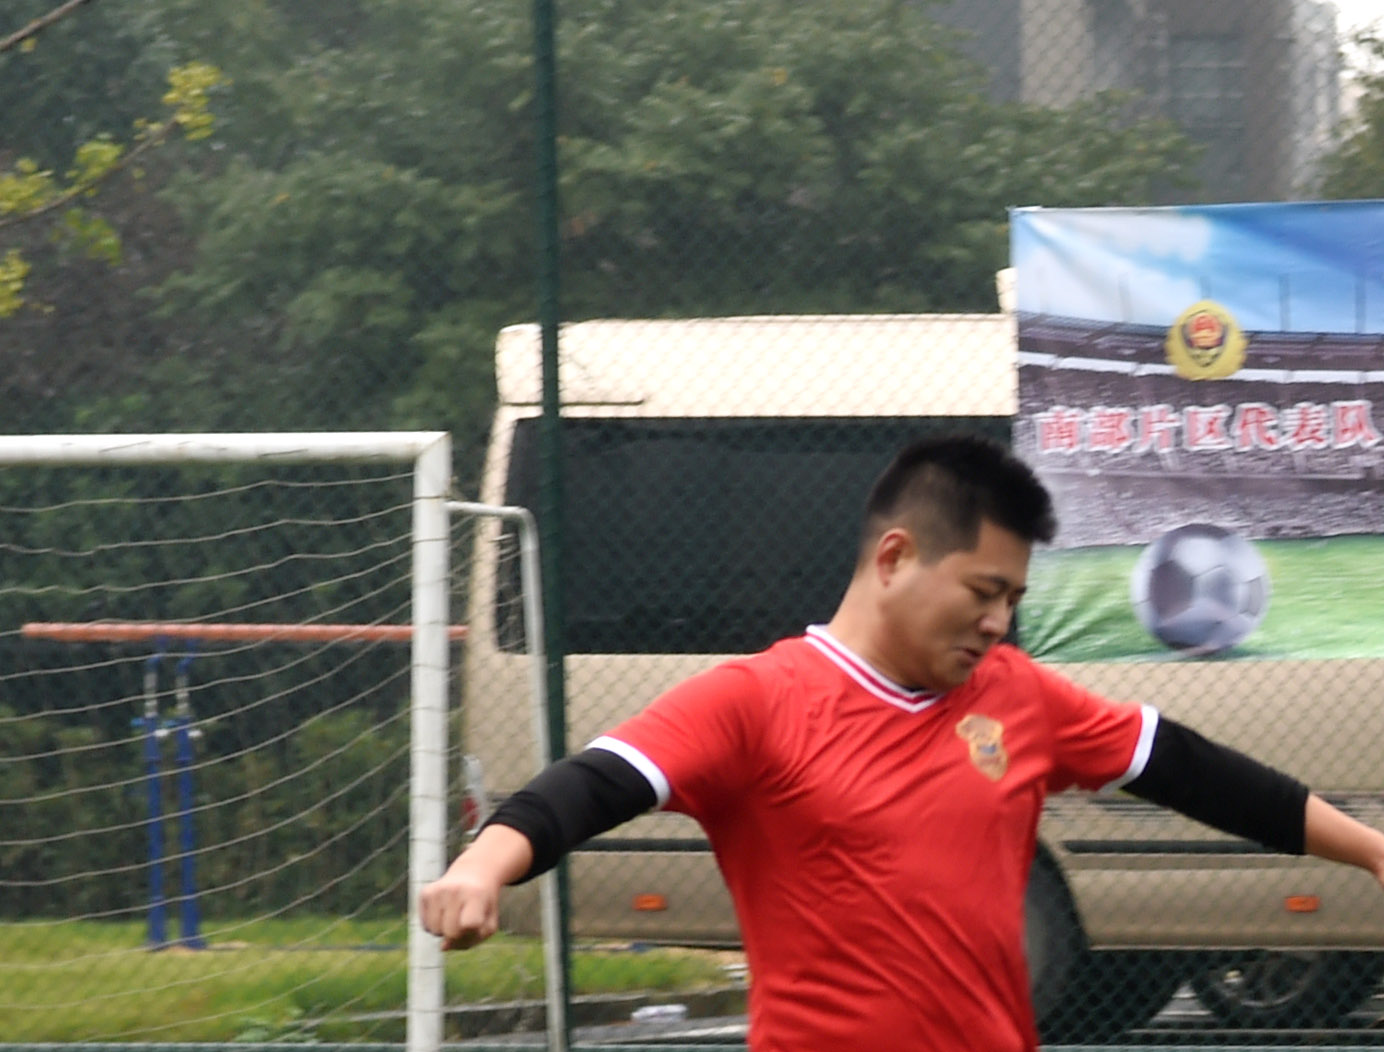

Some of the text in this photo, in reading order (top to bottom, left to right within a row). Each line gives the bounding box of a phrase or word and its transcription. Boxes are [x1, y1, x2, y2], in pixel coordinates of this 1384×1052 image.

[1035, 401, 1380, 453] 南部片区代表队
